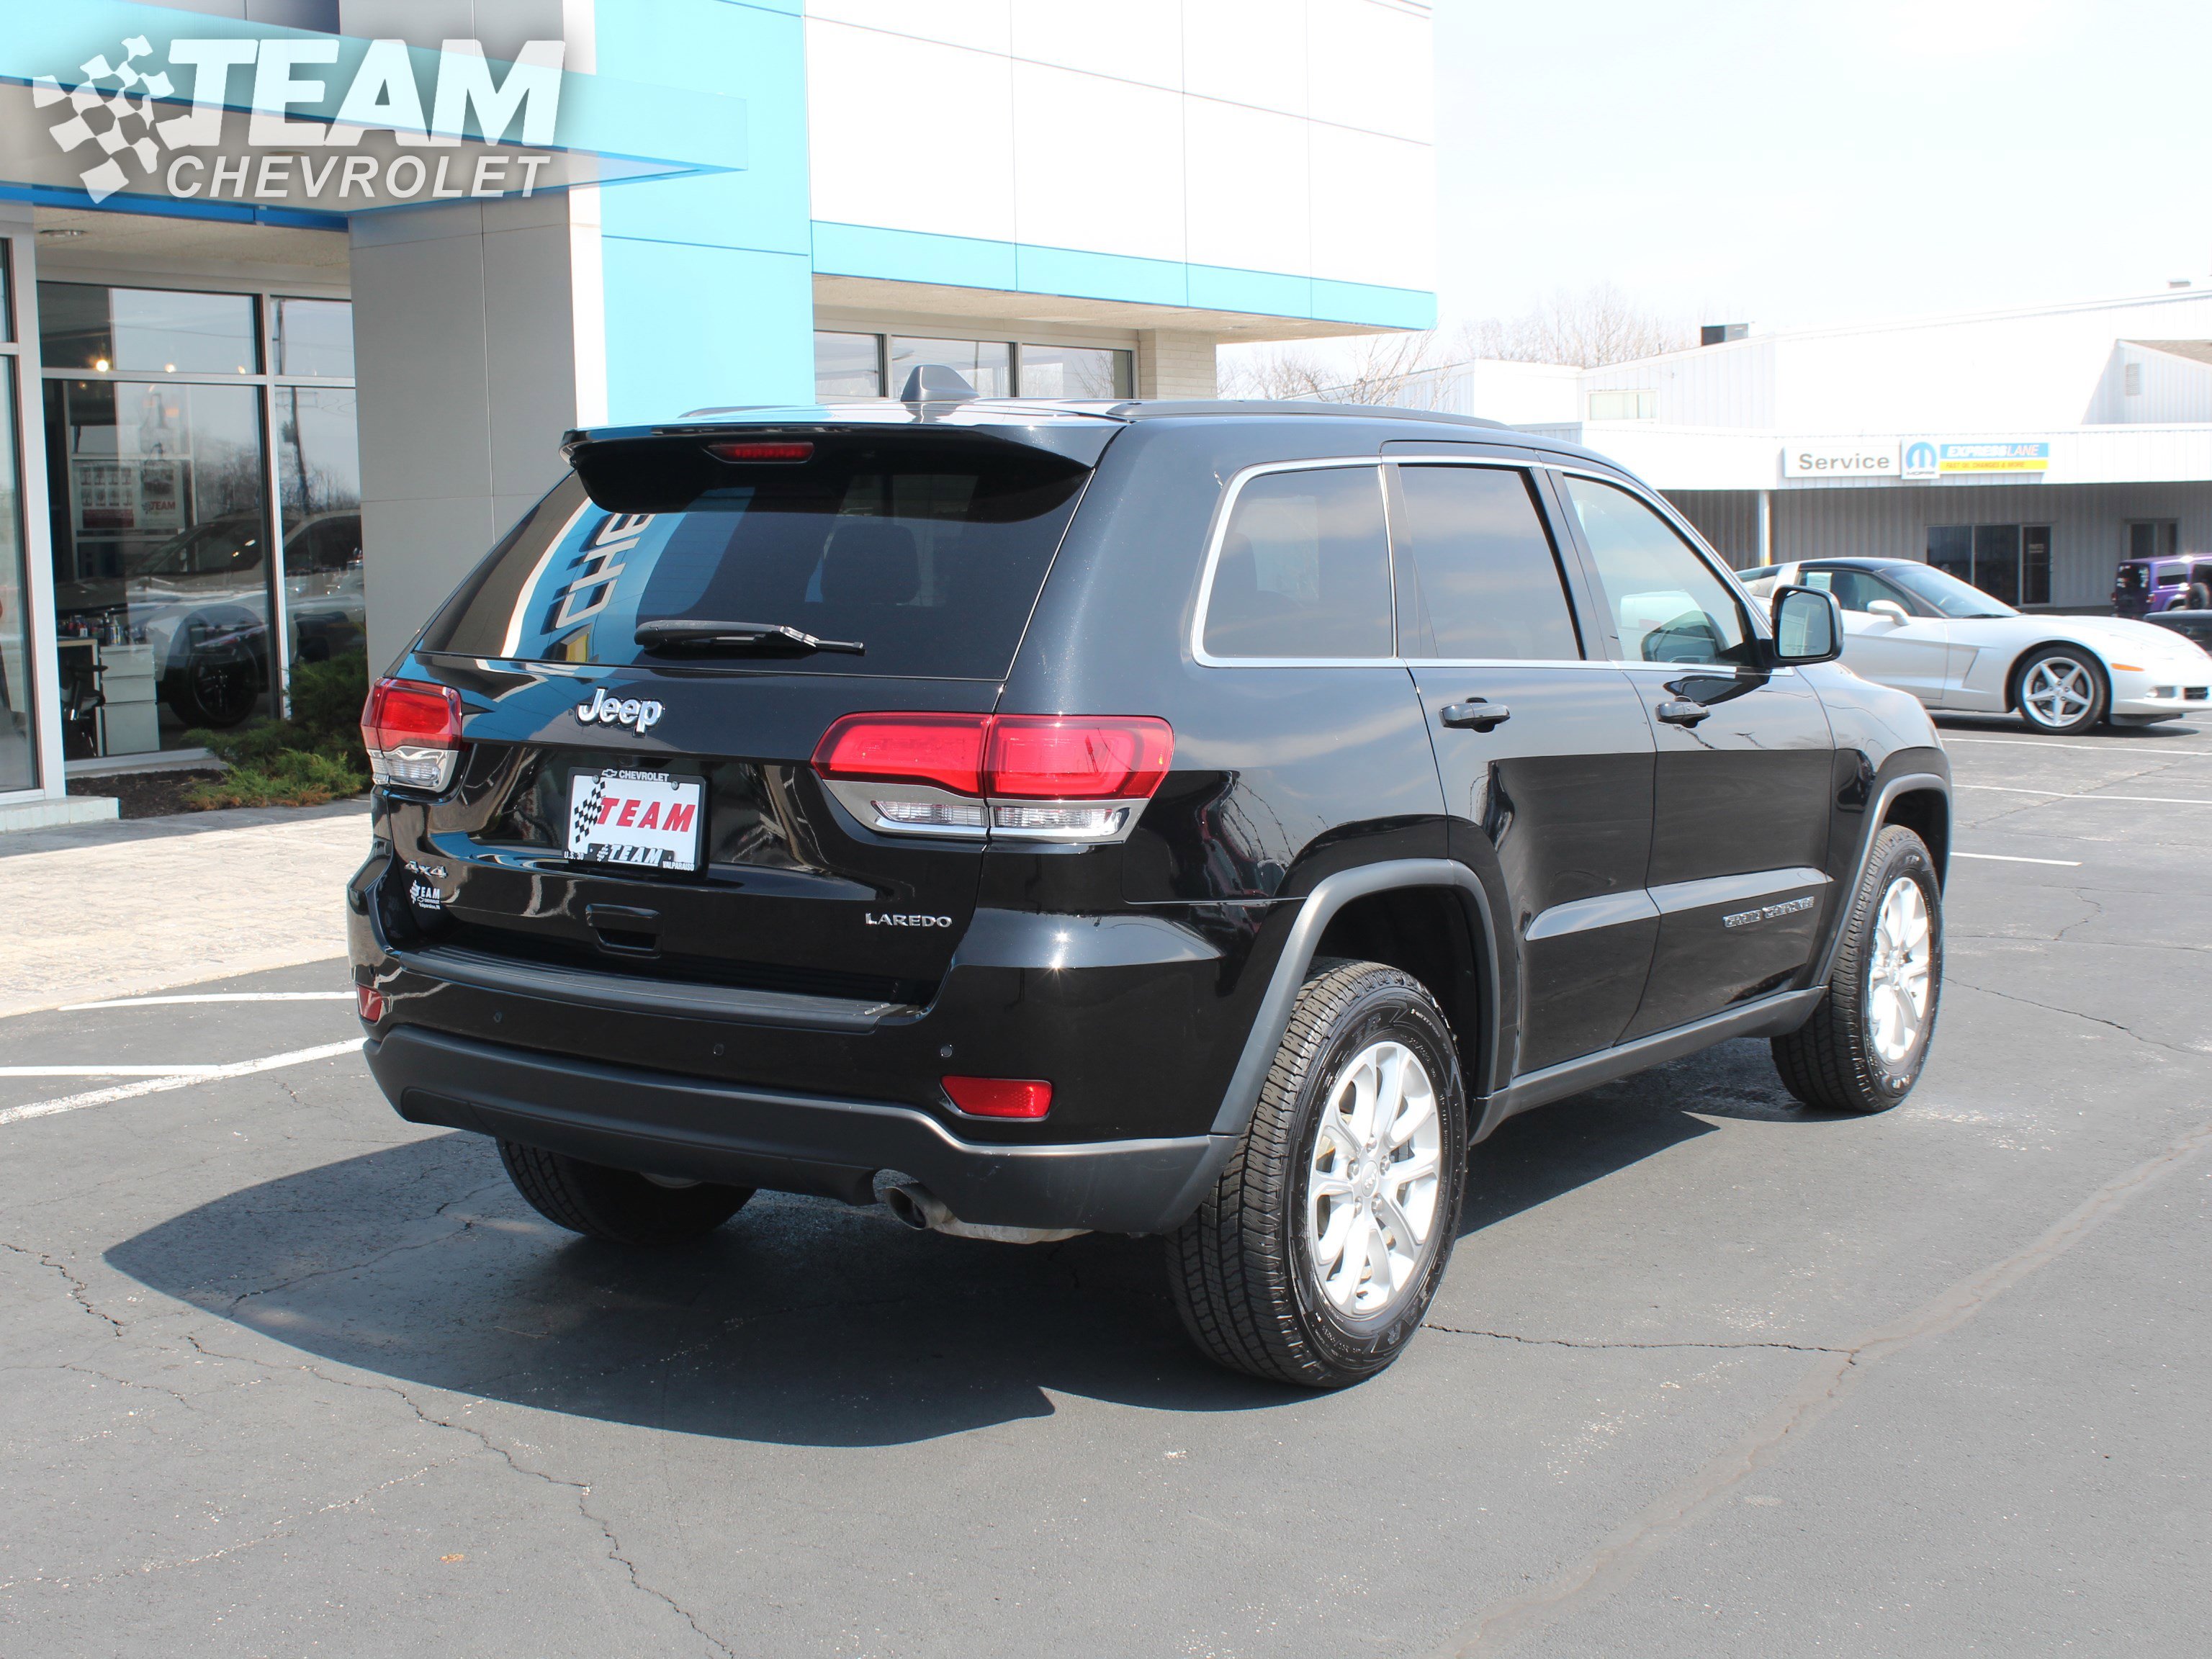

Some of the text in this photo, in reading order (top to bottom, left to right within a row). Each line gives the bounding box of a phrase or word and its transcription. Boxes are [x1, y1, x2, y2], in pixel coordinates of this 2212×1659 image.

[1799, 453, 1890, 470] Service
[577, 687, 664, 734] Jeep
[619, 770, 670, 782] CHEVROLET
[597, 797, 696, 832] TEAM
[608, 844, 663, 864] TEAM
[662, 860, 695, 871] VALPARAISO
[415, 886, 441, 900] TEAM
[865, 912, 953, 927] LAREDO
